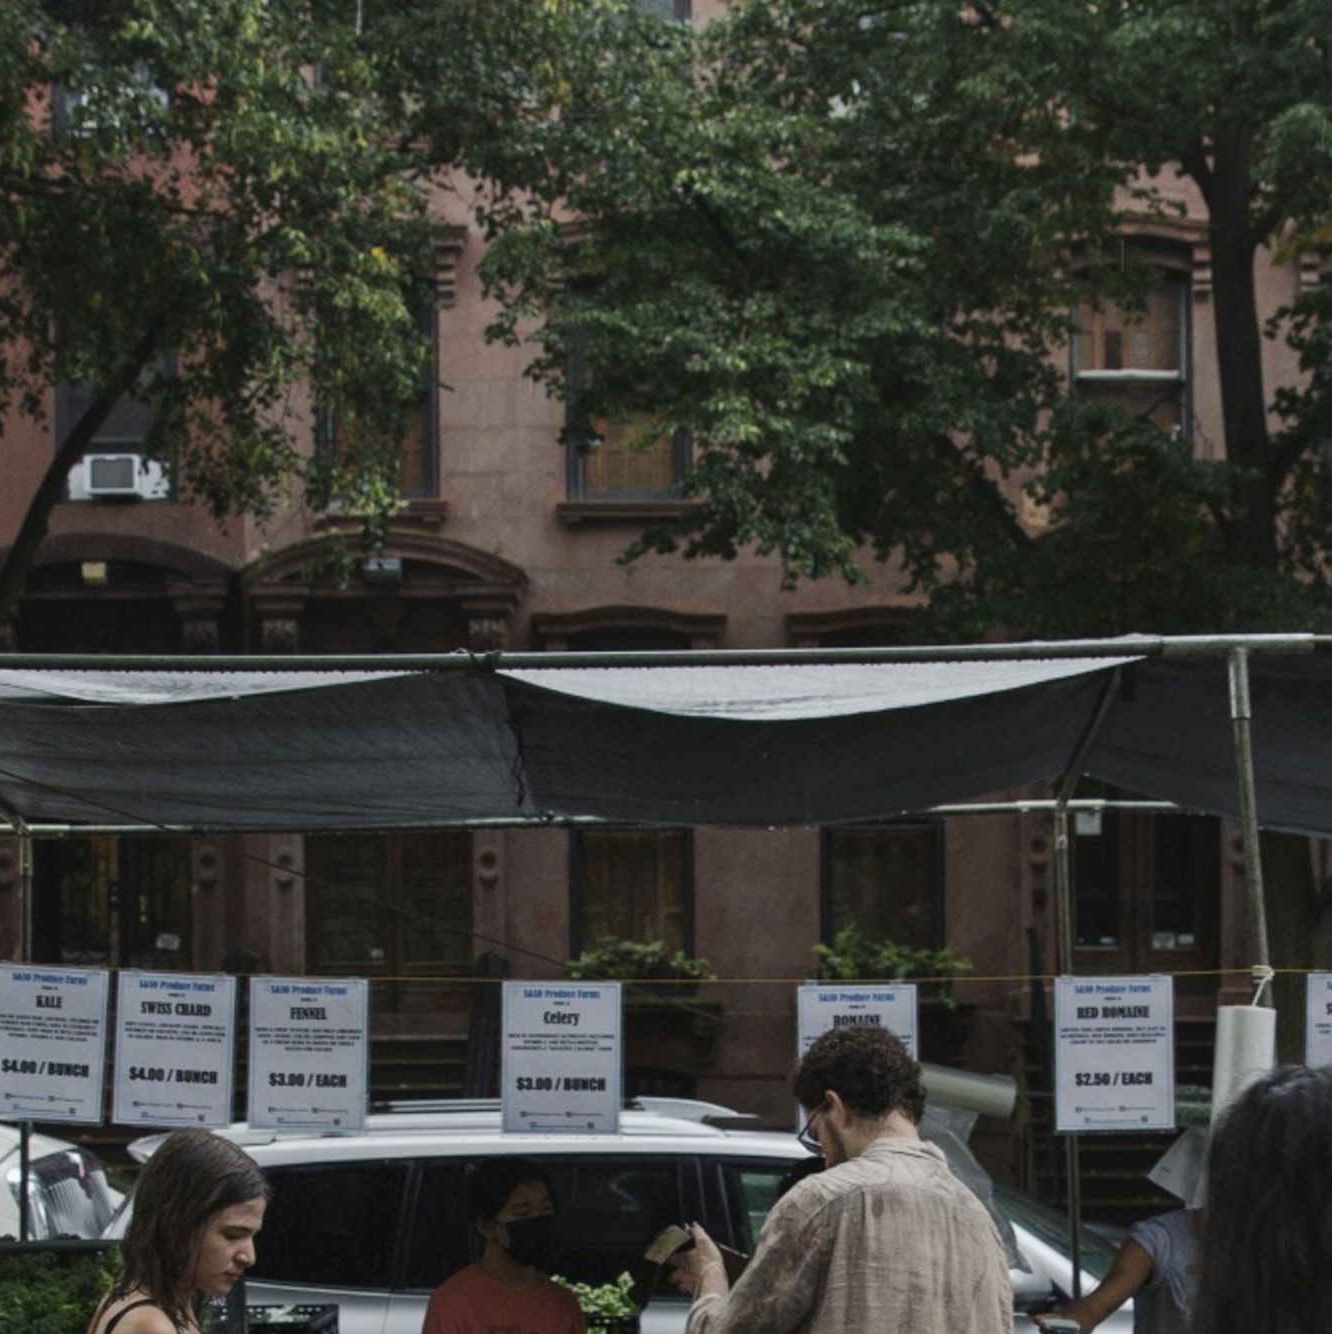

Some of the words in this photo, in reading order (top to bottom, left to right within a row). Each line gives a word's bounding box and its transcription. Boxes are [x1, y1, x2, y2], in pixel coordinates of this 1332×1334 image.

[34, 973, 64, 984] Produce
[66, 974, 88, 985] Farms
[160, 980, 190, 990] Produce
[193, 981, 215, 992] Farms
[292, 985, 323, 995] Produce
[324, 986, 347, 995] Farms
[545, 989, 576, 998] Produce
[578, 989, 601, 999] Farms
[1095, 984, 1126, 994] Produce
[1128, 984, 1151, 993] Farms
[36, 995, 63, 1009] KALE
[840, 993, 870, 1002] Produce
[872, 993, 895, 1002] Farms
[141, 1001, 173, 1015] SWISS
[175, 1003, 211, 1016] CHARD
[290, 1007, 328, 1020] FENNEL
[1077, 1007, 1098, 1019] RED
[1101, 1005, 1150, 1018] ROMAINE
[543, 1011, 580, 1026] Celery
[833, 1014, 882, 1028] ROMAINE
[1, 1059, 36, 1073] $4.00
[48, 1062, 89, 1077] BUNCH
[129, 1067, 164, 1081] $4.00
[175, 1069, 218, 1084] BUNCH
[269, 1072, 305, 1087] $3.00
[315, 1074, 347, 1088] EACH
[1075, 1072, 1110, 1086] $2.50
[1121, 1072, 1153, 1085] EACH
[516, 1076, 552, 1090] $3.00
[563, 1077, 606, 1091] BUNCH
